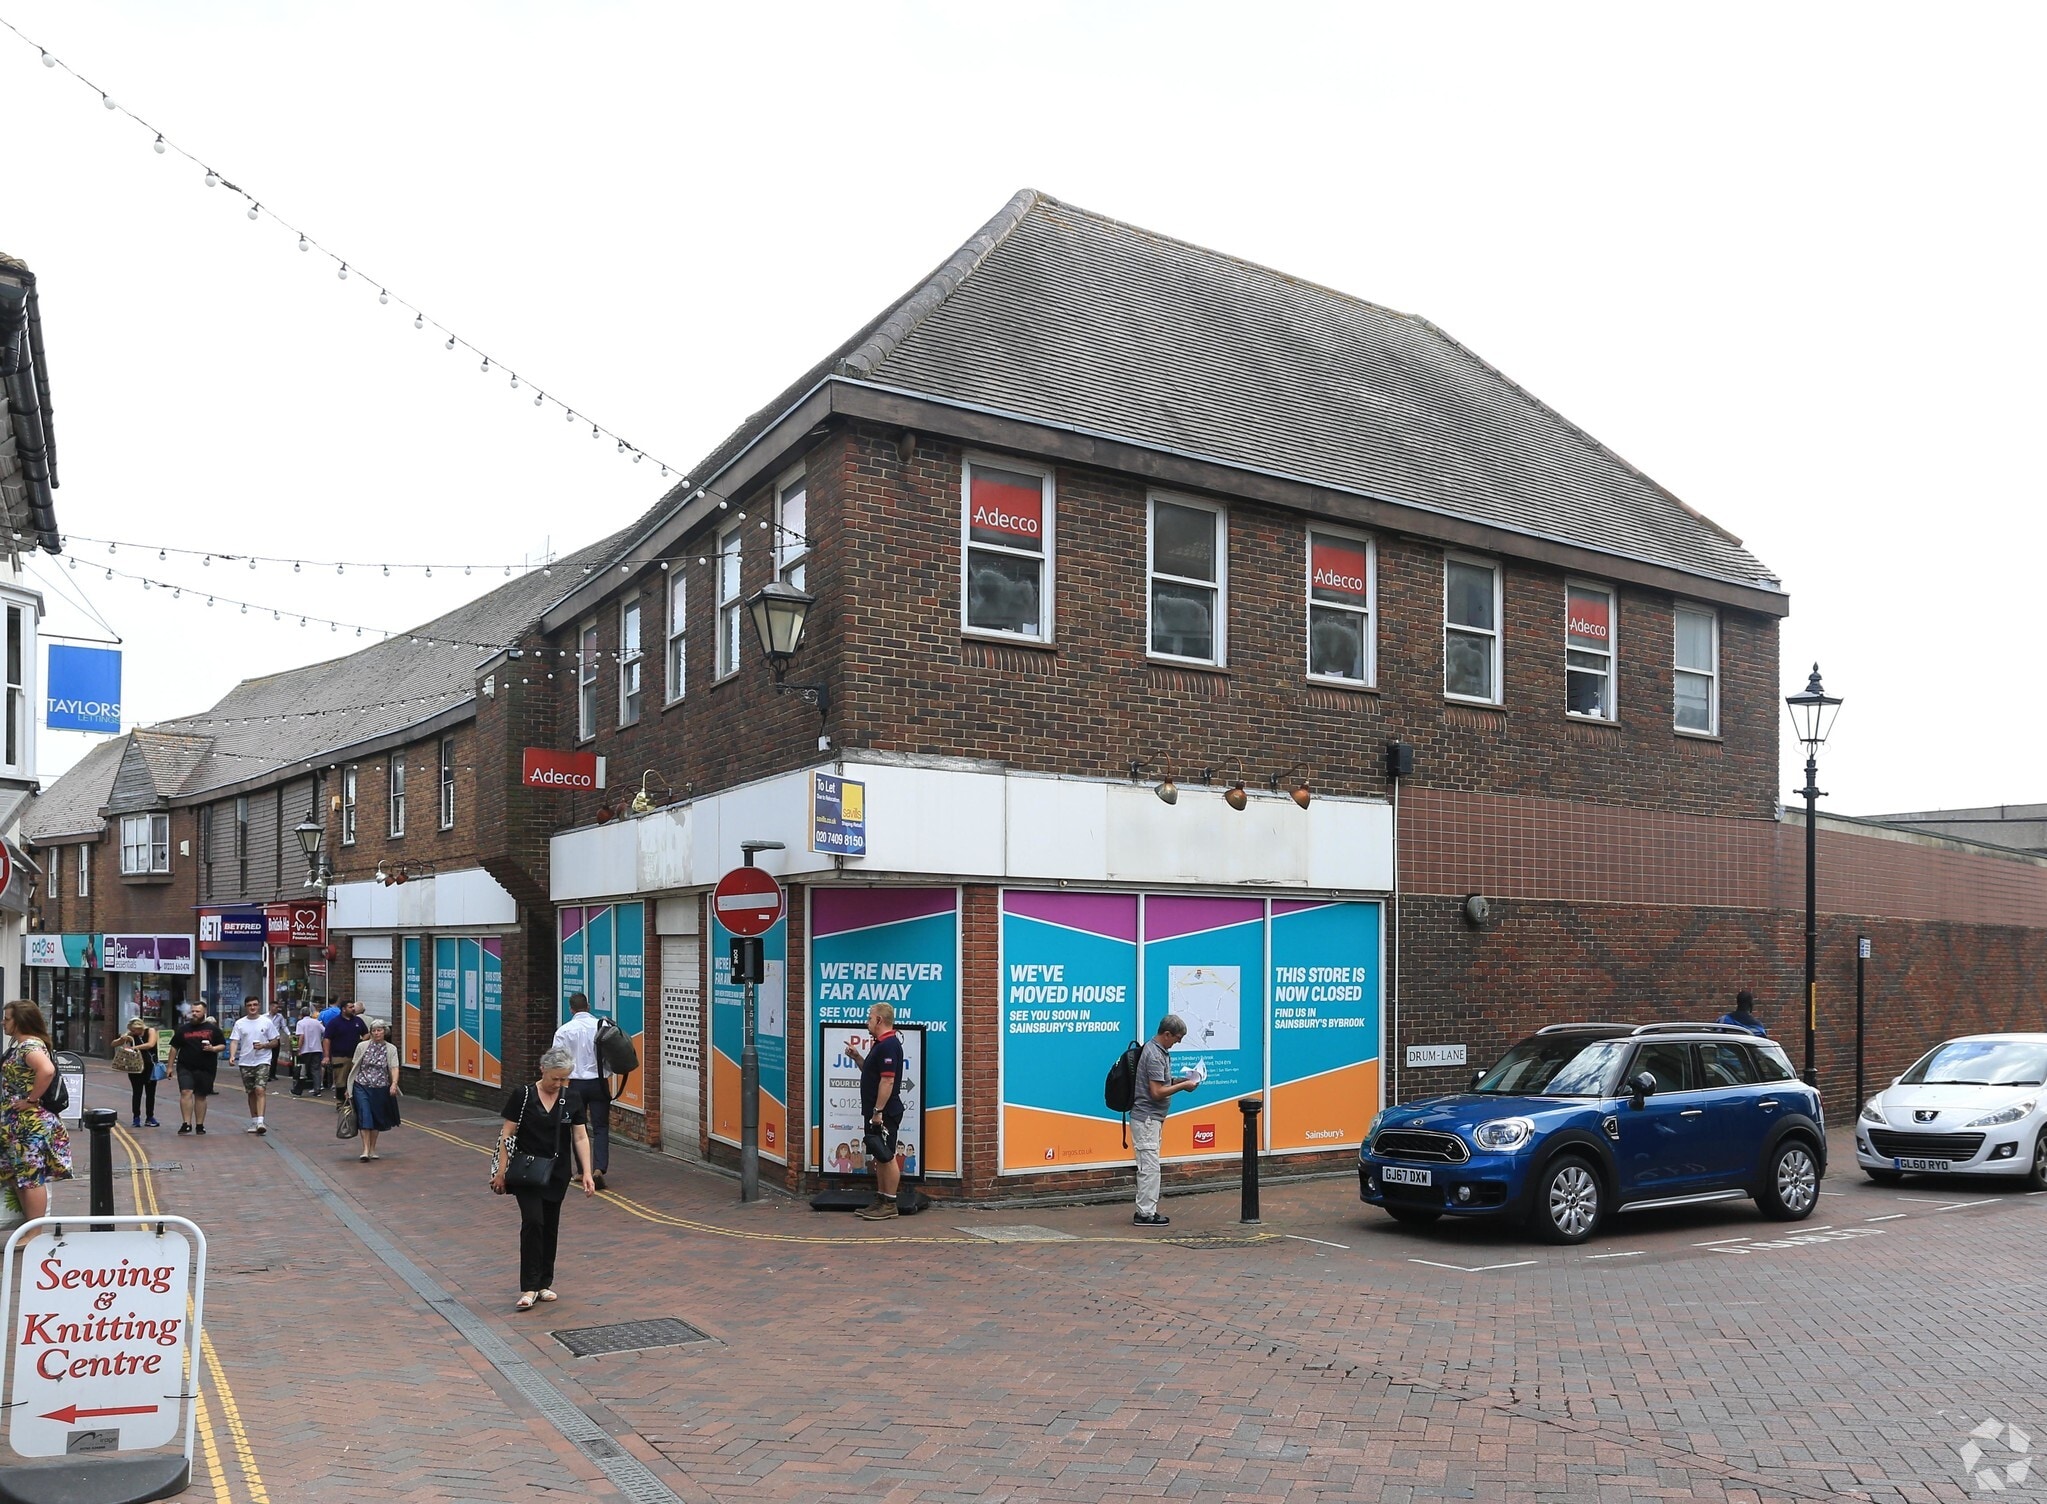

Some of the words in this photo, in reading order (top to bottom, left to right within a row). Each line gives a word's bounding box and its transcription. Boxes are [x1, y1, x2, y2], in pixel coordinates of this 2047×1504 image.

[973, 505, 1038, 533] Adecco
[1314, 567, 1363, 591] Adecco
[1569, 617, 1606, 637] Adecco
[48, 698, 120, 717] TAYLORS
[77, 714, 120, 725] LETTINGS
[529, 767, 591, 787] Adecco
[816, 778, 825, 791] To
[825, 780, 836, 794] Let
[842, 807, 862, 820] savills
[815, 830, 827, 843] 020
[827, 832, 844, 845] 7409
[844, 834, 863, 847] 8150
[224, 922, 262, 931] BETFRED
[116, 942, 128, 959] Pet
[820, 962, 878, 980] WE'RE
[881, 963, 943, 981] NEVER
[1010, 964, 1064, 982] WE'VE
[1275, 967, 1306, 983] THIS
[1308, 967, 1350, 983] STORE
[1352, 967, 1366, 983] IS
[820, 983, 854, 1000] FAR
[857, 983, 912, 1001] AWAY
[1010, 985, 1069, 1004] MOVED
[1071, 985, 1126, 1003] HOUSE
[1275, 986, 1310, 1002] NOW
[1311, 985, 1362, 1002] CLOSED
[819, 1006, 840, 1018] SEE
[843, 1007, 864, 1018] YOU
[899, 1007, 911, 1019] IN
[1009, 1010, 1029, 1021] SEE
[1031, 1010, 1050, 1021] YOU
[1051, 1010, 1078, 1021] SOON
[1080, 1009, 1091, 1020] IN
[1274, 1008, 1294, 1018] FIND
[1295, 1008, 1306, 1018] US
[1307, 1007, 1317, 1018] IN
[1009, 1022, 1074, 1034] SAINSBURY'S
[1075, 1021, 1121, 1032] BYBROOK
[1274, 1018, 1328, 1029] SAINSBURY'S
[1328, 1017, 1366, 1028] BYBROOK
[830, 1079, 850, 1087] YOUR
[1194, 1130, 1214, 1140] Argos
[1305, 1128, 1344, 1140] Sainsbury's
[1062, 1149, 1093, 1158] argos.co.uk
[1900, 1158, 1926, 1169] GL60
[1385, 1168, 1408, 1181] GJ67
[1409, 1170, 1428, 1184] DXW
[36, 1258, 175, 1294] Sewing
[93, 1292, 117, 1311] &
[20, 1311, 182, 1346] Knitting
[36, 1348, 162, 1380] Centre
